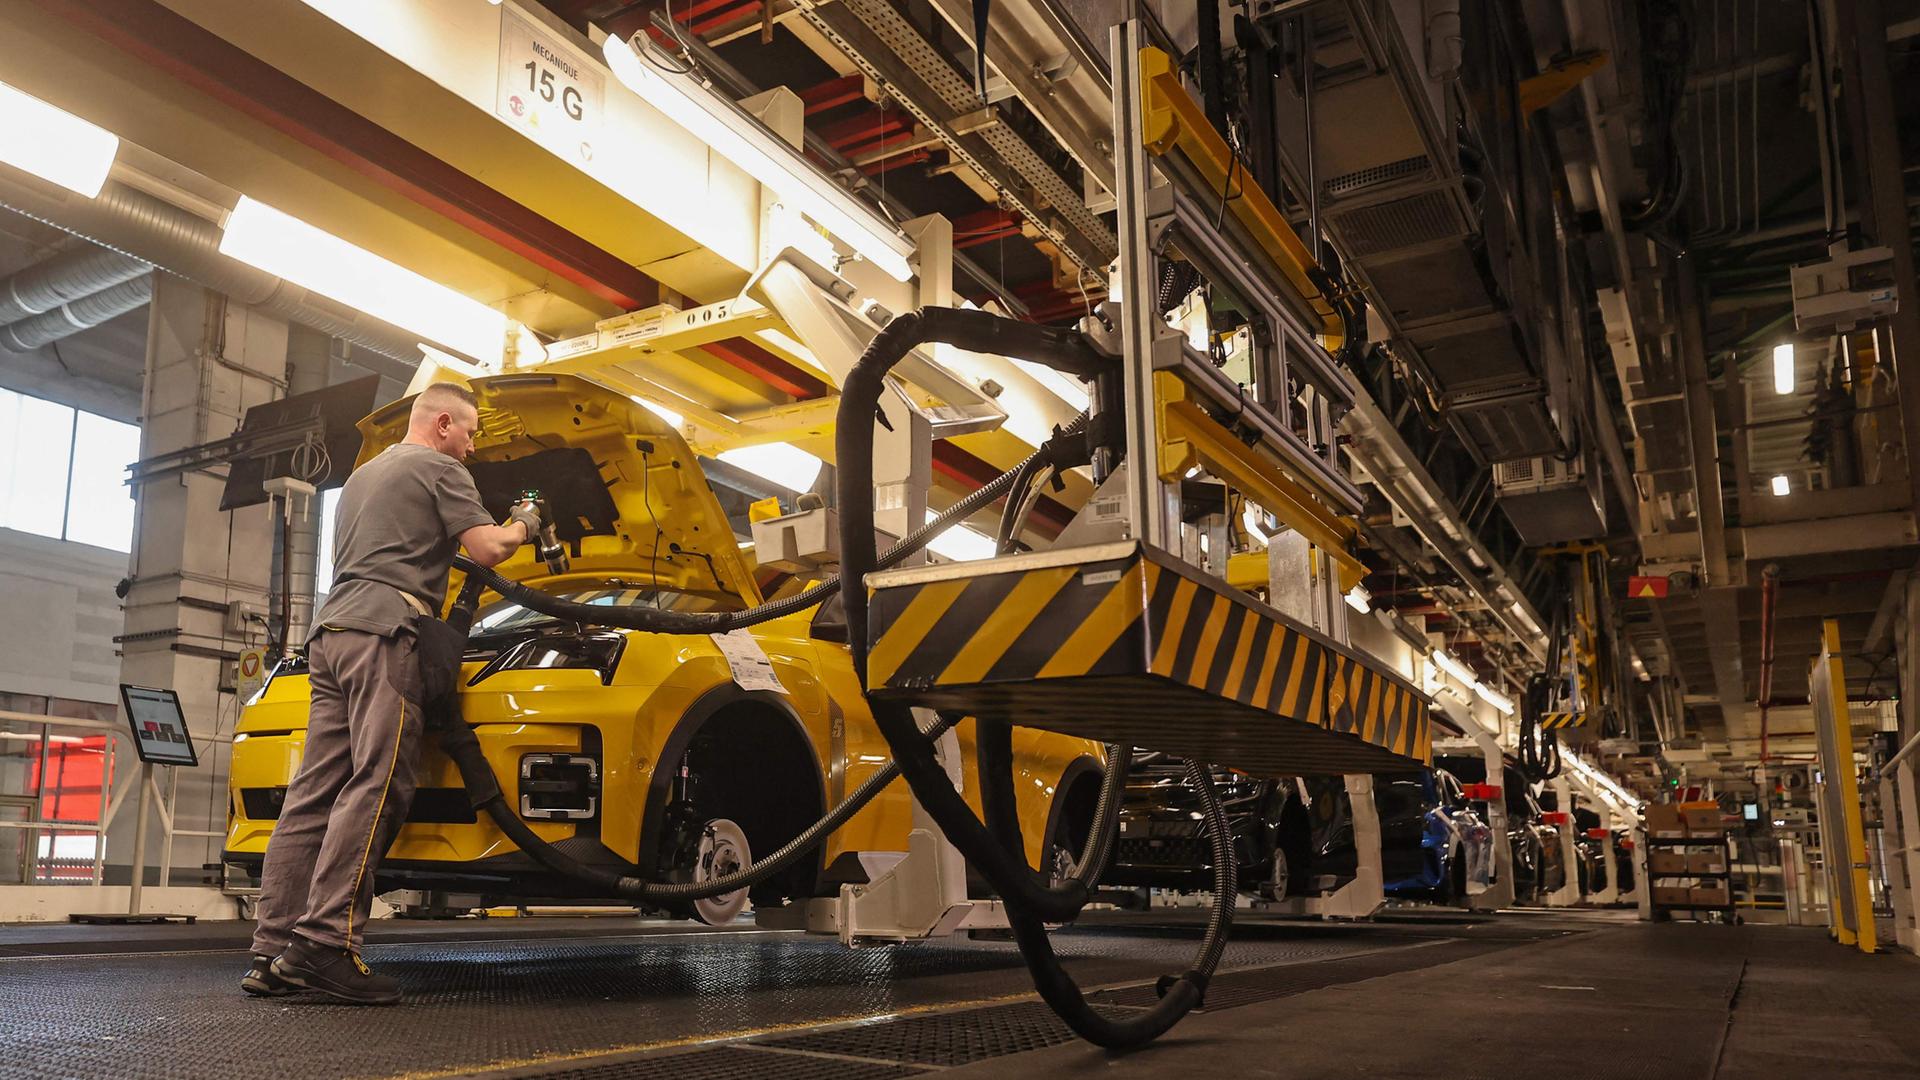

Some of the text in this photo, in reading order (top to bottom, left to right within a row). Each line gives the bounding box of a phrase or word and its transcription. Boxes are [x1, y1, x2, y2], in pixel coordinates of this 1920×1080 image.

[532, 41, 579, 81] MECANIQUE
[525, 60, 583, 121] 15 G
